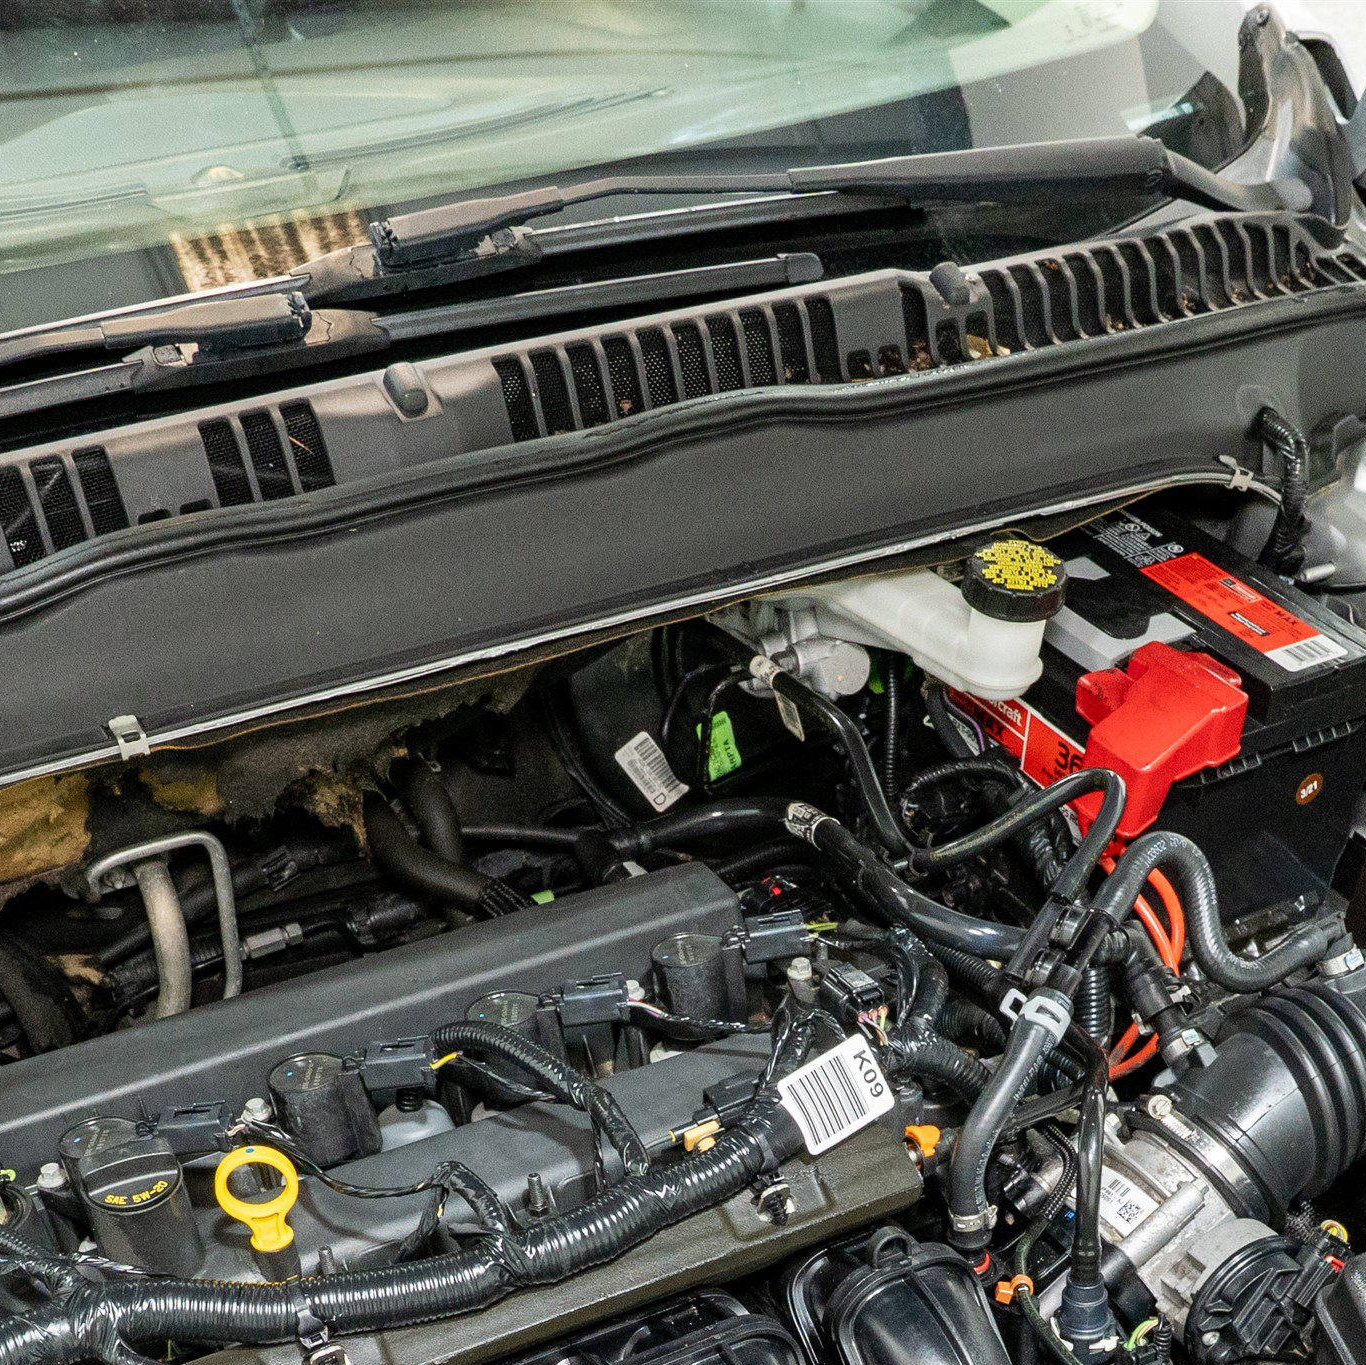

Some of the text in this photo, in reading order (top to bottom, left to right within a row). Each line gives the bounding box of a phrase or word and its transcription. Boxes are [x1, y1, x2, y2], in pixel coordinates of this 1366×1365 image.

[1300, 780, 1318, 799] 3/21
[853, 1049, 884, 1099] K09
[104, 1180, 168, 1205] SAE 5W-20
